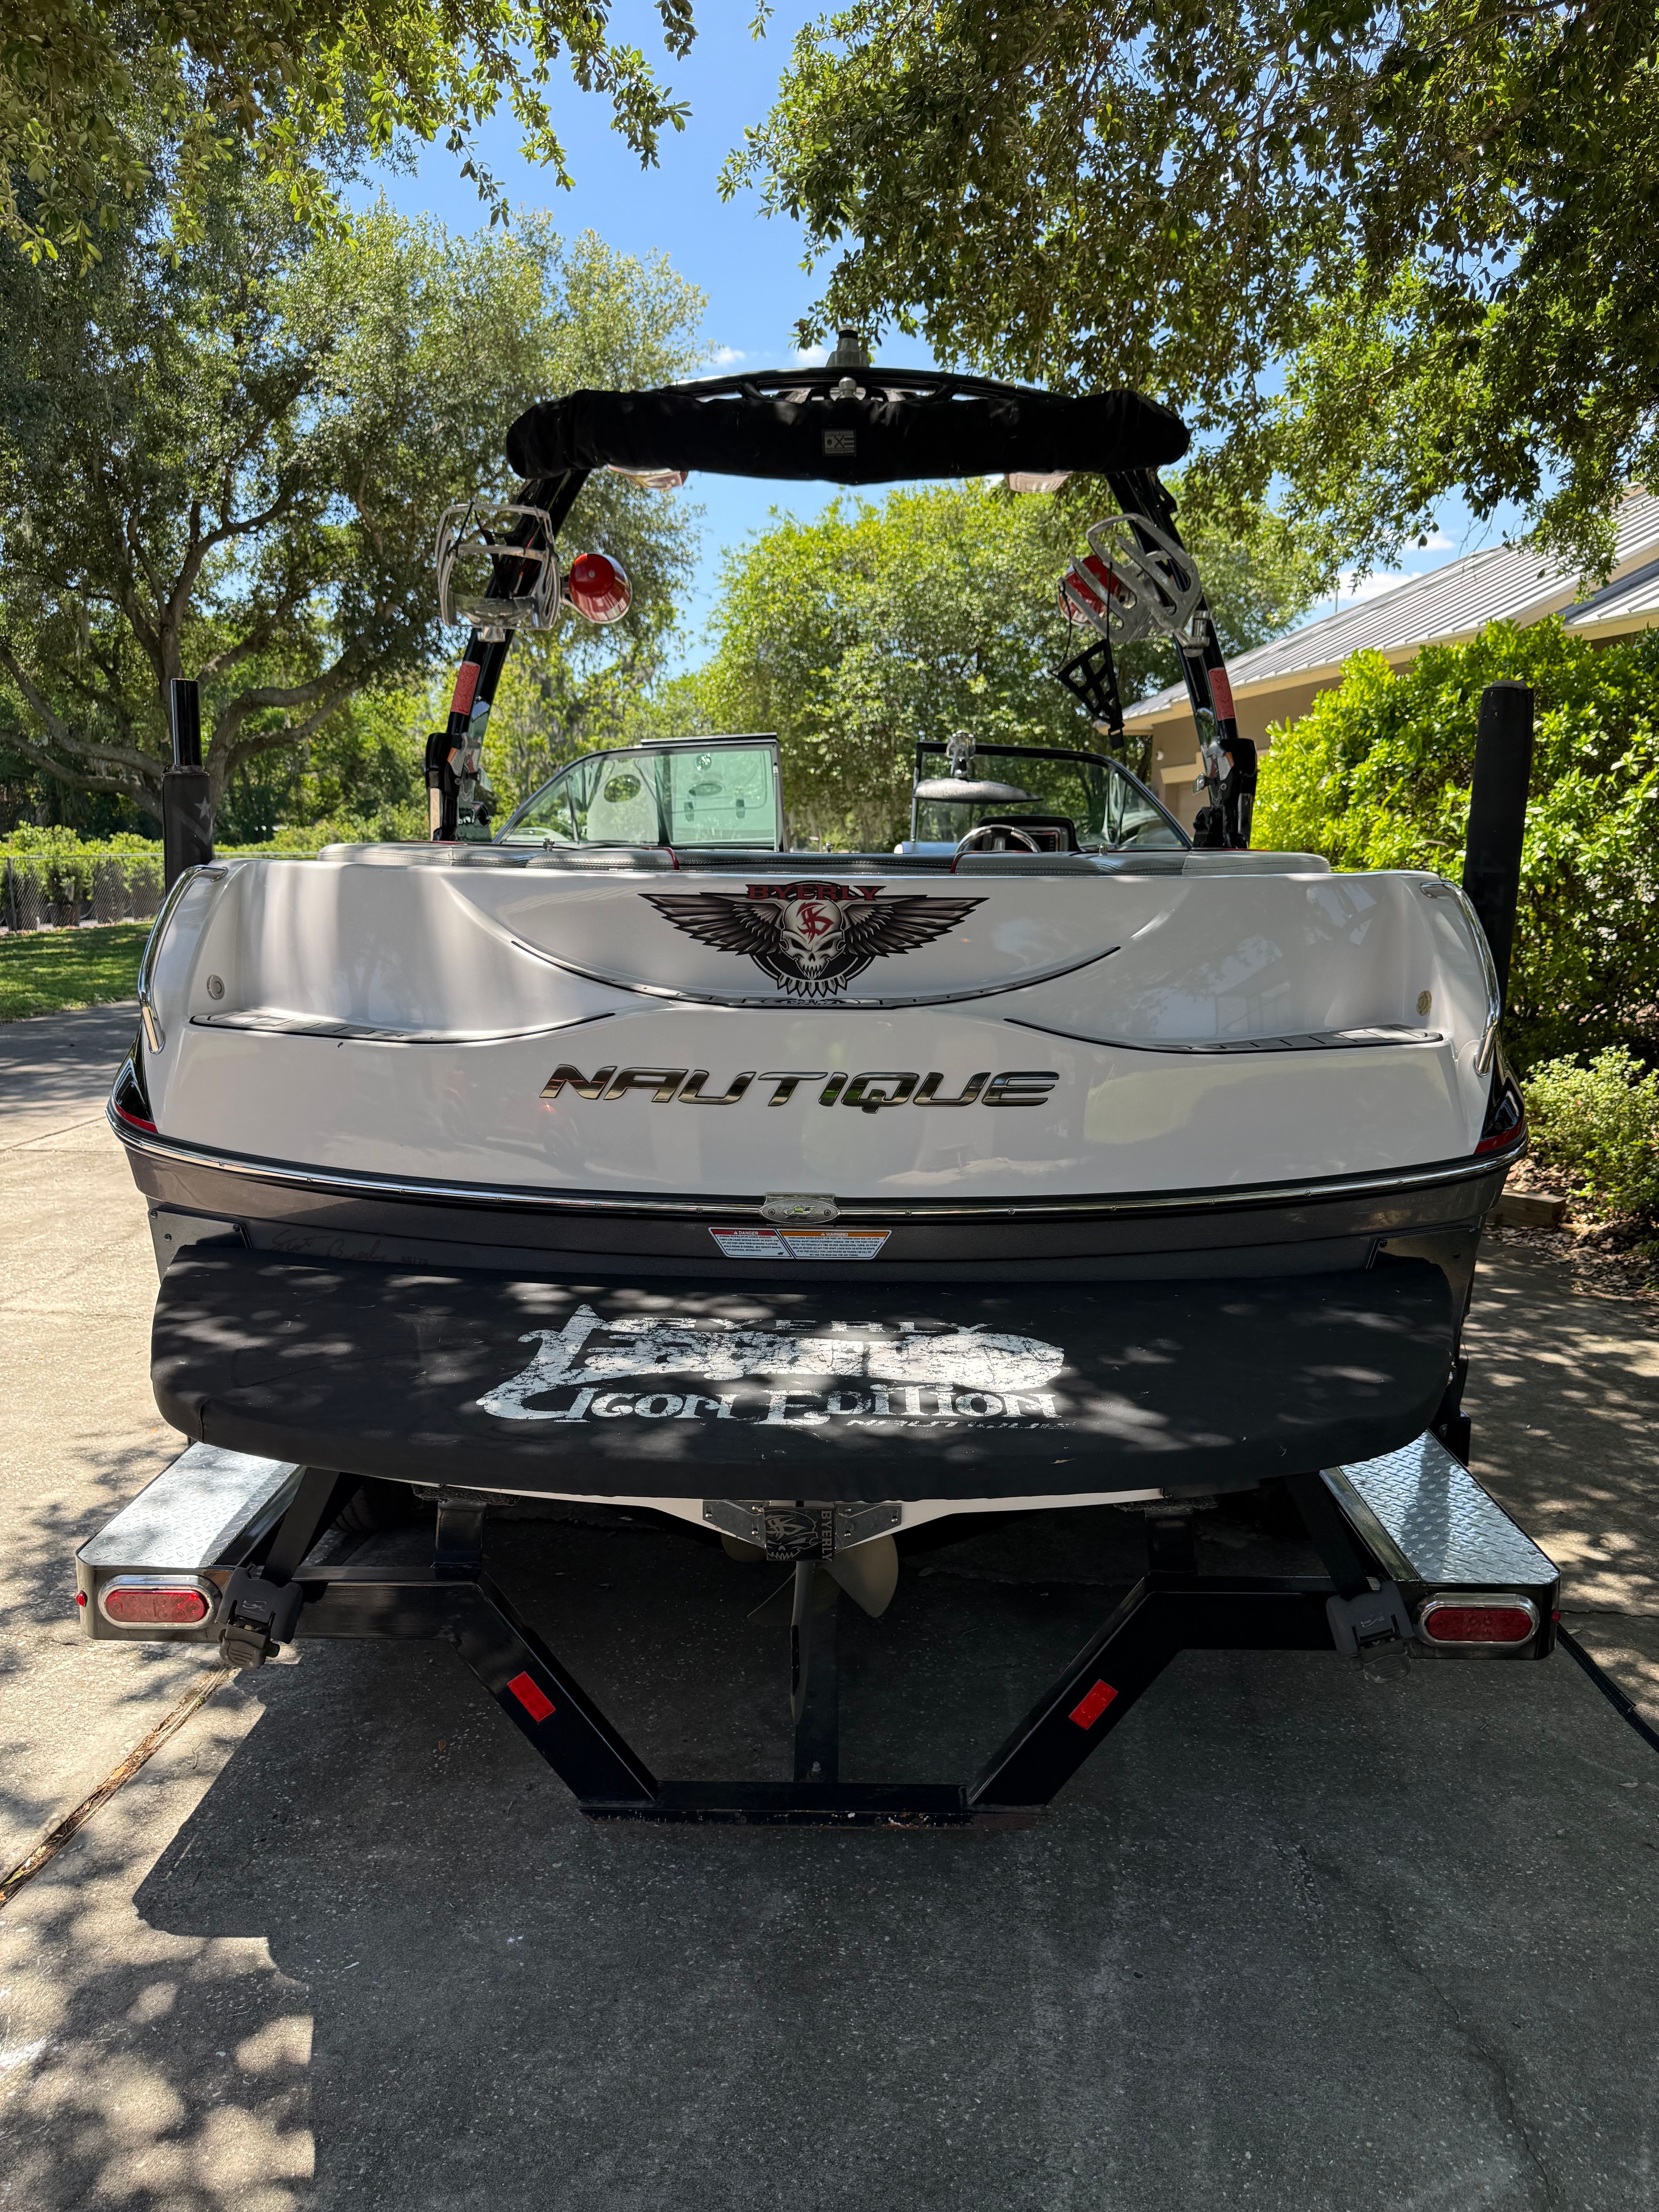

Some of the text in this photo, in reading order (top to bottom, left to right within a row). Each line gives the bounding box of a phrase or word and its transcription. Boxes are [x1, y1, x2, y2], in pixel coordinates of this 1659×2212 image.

[747, 884, 884, 901] BYERLY
[539, 1064, 1059, 1114] NAUTIQUE
[821, 1510, 833, 1561] BYERLY
